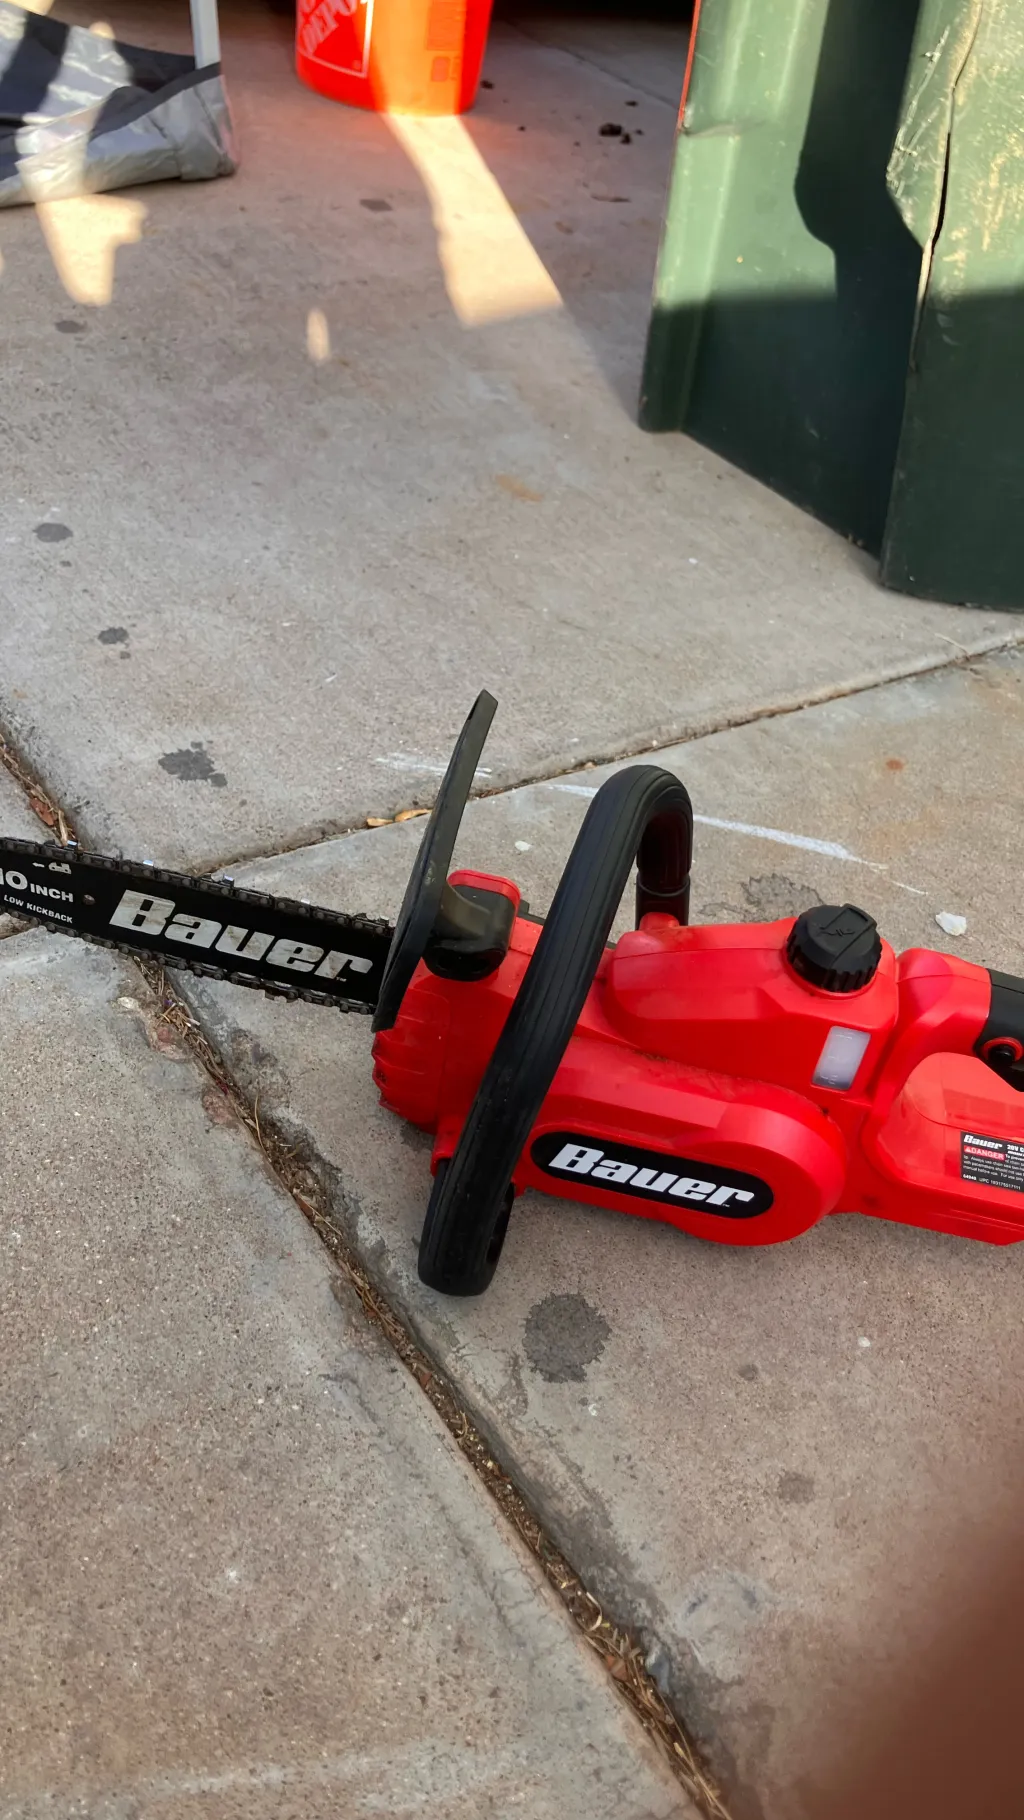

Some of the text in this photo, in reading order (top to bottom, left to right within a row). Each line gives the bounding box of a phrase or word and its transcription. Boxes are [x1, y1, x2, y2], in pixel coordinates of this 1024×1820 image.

[302, 0, 366, 56] DEPO
[30, 883, 74, 903] INCH
[4, 894, 73, 924] LOW KICKBACK
[109, 889, 374, 980] Bauer
[964, 1135, 1003, 1149] Bauer
[971, 1148, 1004, 1160] DANGER
[548, 1142, 755, 1206] Bauer
